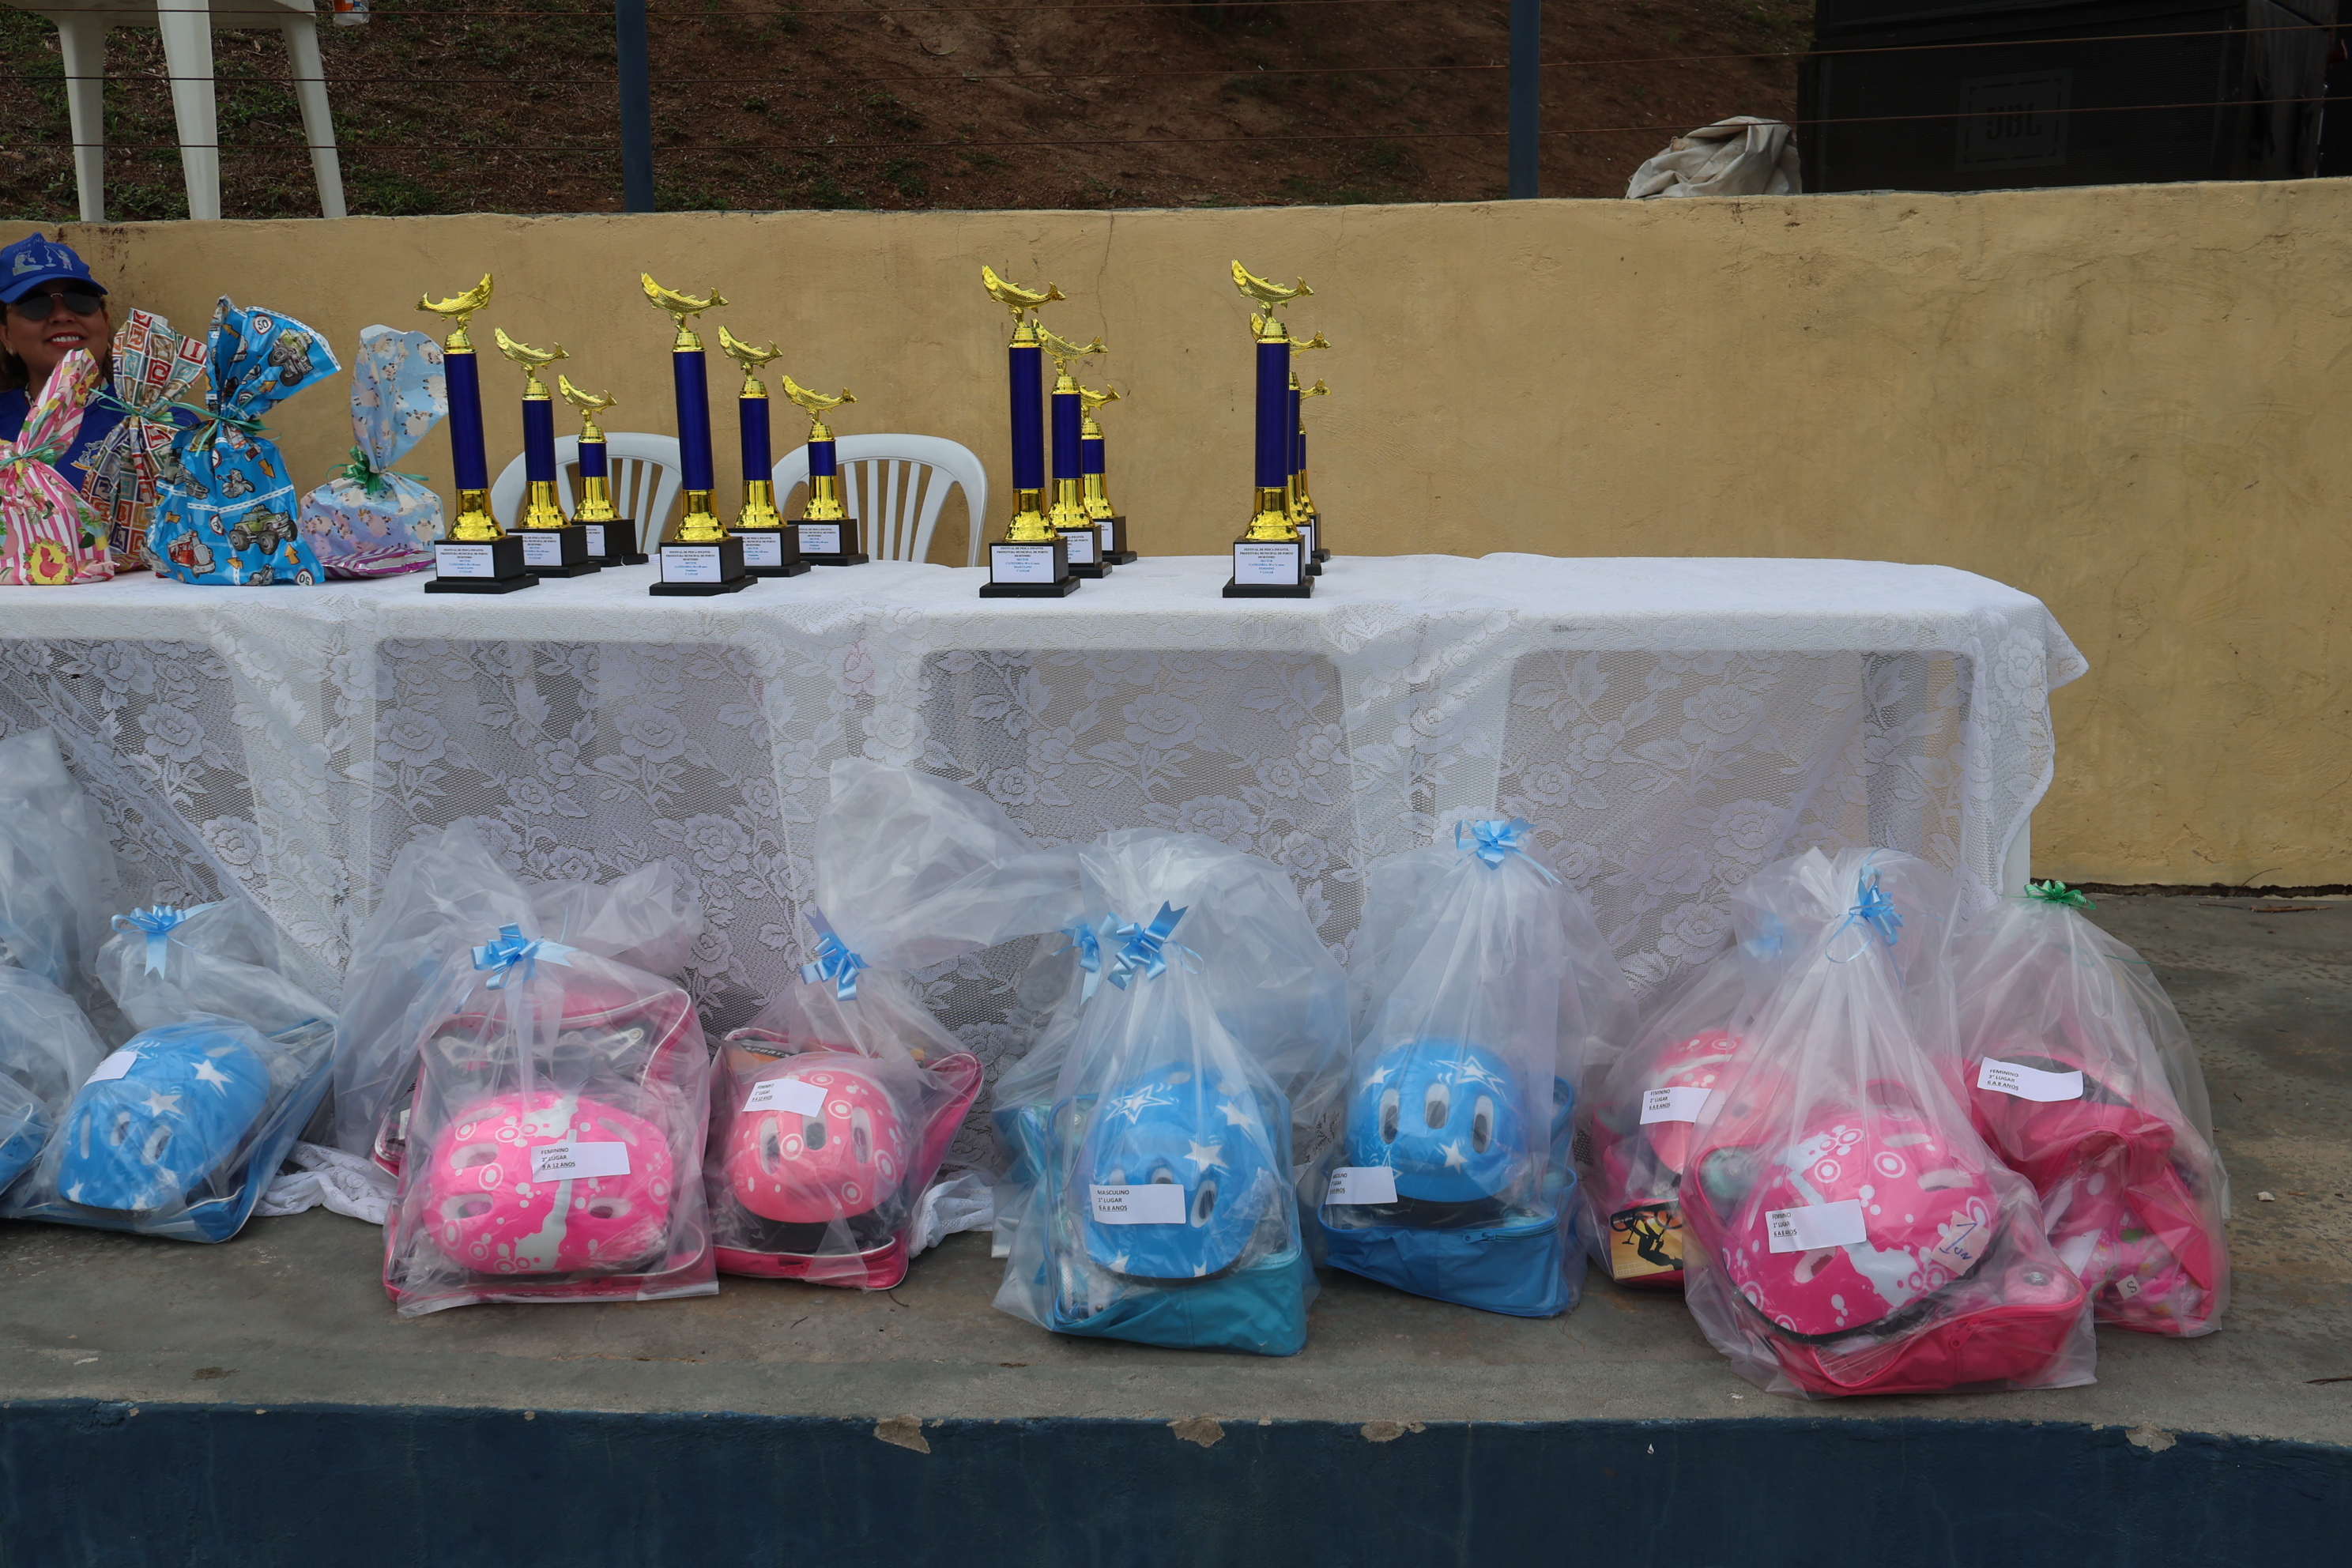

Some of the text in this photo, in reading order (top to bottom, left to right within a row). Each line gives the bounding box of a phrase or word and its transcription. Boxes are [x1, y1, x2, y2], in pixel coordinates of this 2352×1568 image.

[1986, 104, 2042, 140] JBL
[257, 319, 270, 330] 50
[745, 1046, 790, 1057] SPORTS
[2127, 1280, 2137, 1293] S
